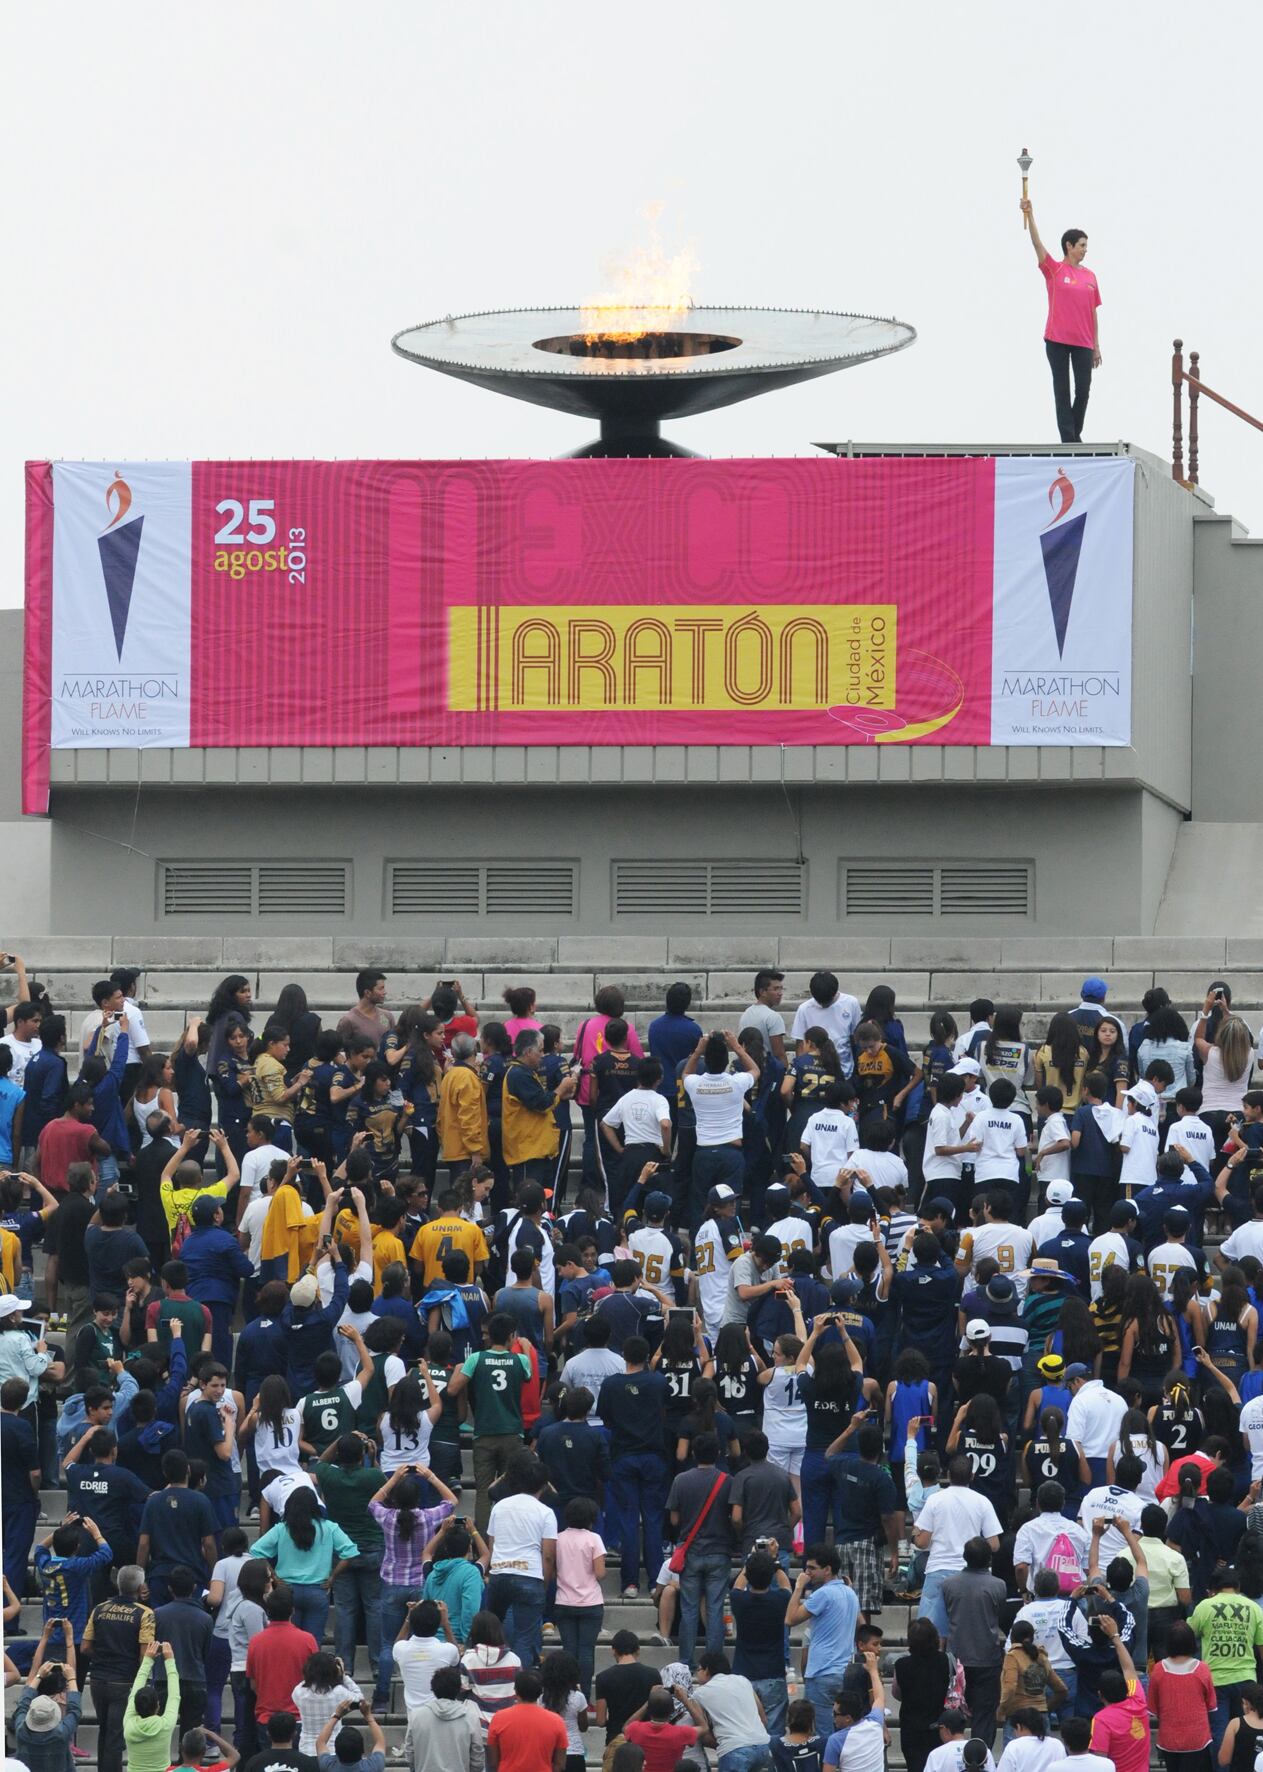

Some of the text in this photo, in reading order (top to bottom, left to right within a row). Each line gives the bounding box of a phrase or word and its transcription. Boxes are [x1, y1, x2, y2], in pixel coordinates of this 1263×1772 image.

[214, 498, 276, 545] 25
[287, 527, 306, 585] 2013
[846, 616, 861, 705] Ciudad de
[865, 616, 886, 705] México
[61, 679, 178, 699] MARATHON
[1001, 677, 1120, 697] MARATHON
[90, 702, 148, 720] FLAME
[1031, 699, 1089, 718] FLAME
[815, 1123, 838, 1133] UNAM
[987, 1120, 1012, 1130] UNAM
[1186, 1131, 1207, 1140] UNAM
[432, 1225, 463, 1233] UNAM
[435, 1235, 454, 1262] 4
[997, 1245, 1015, 1273] 9
[1214, 1321, 1237, 1331] UNAM
[484, 1358, 514, 1366] SEBASTIAN
[491, 1369, 508, 1391] 3
[664, 1371, 691, 1397] 31
[312, 1396, 340, 1407] ALBERTO
[321, 1407, 339, 1431] 6
[1162, 1410, 1194, 1421] PUAS
[272, 1426, 293, 1450] 10
[392, 1430, 419, 1451] 13
[1170, 1424, 1187, 1449] 2
[1041, 1457, 1058, 1477] 6
[80, 1481, 108, 1490] EDRIB
[1209, 1643, 1246, 1658] 2010
